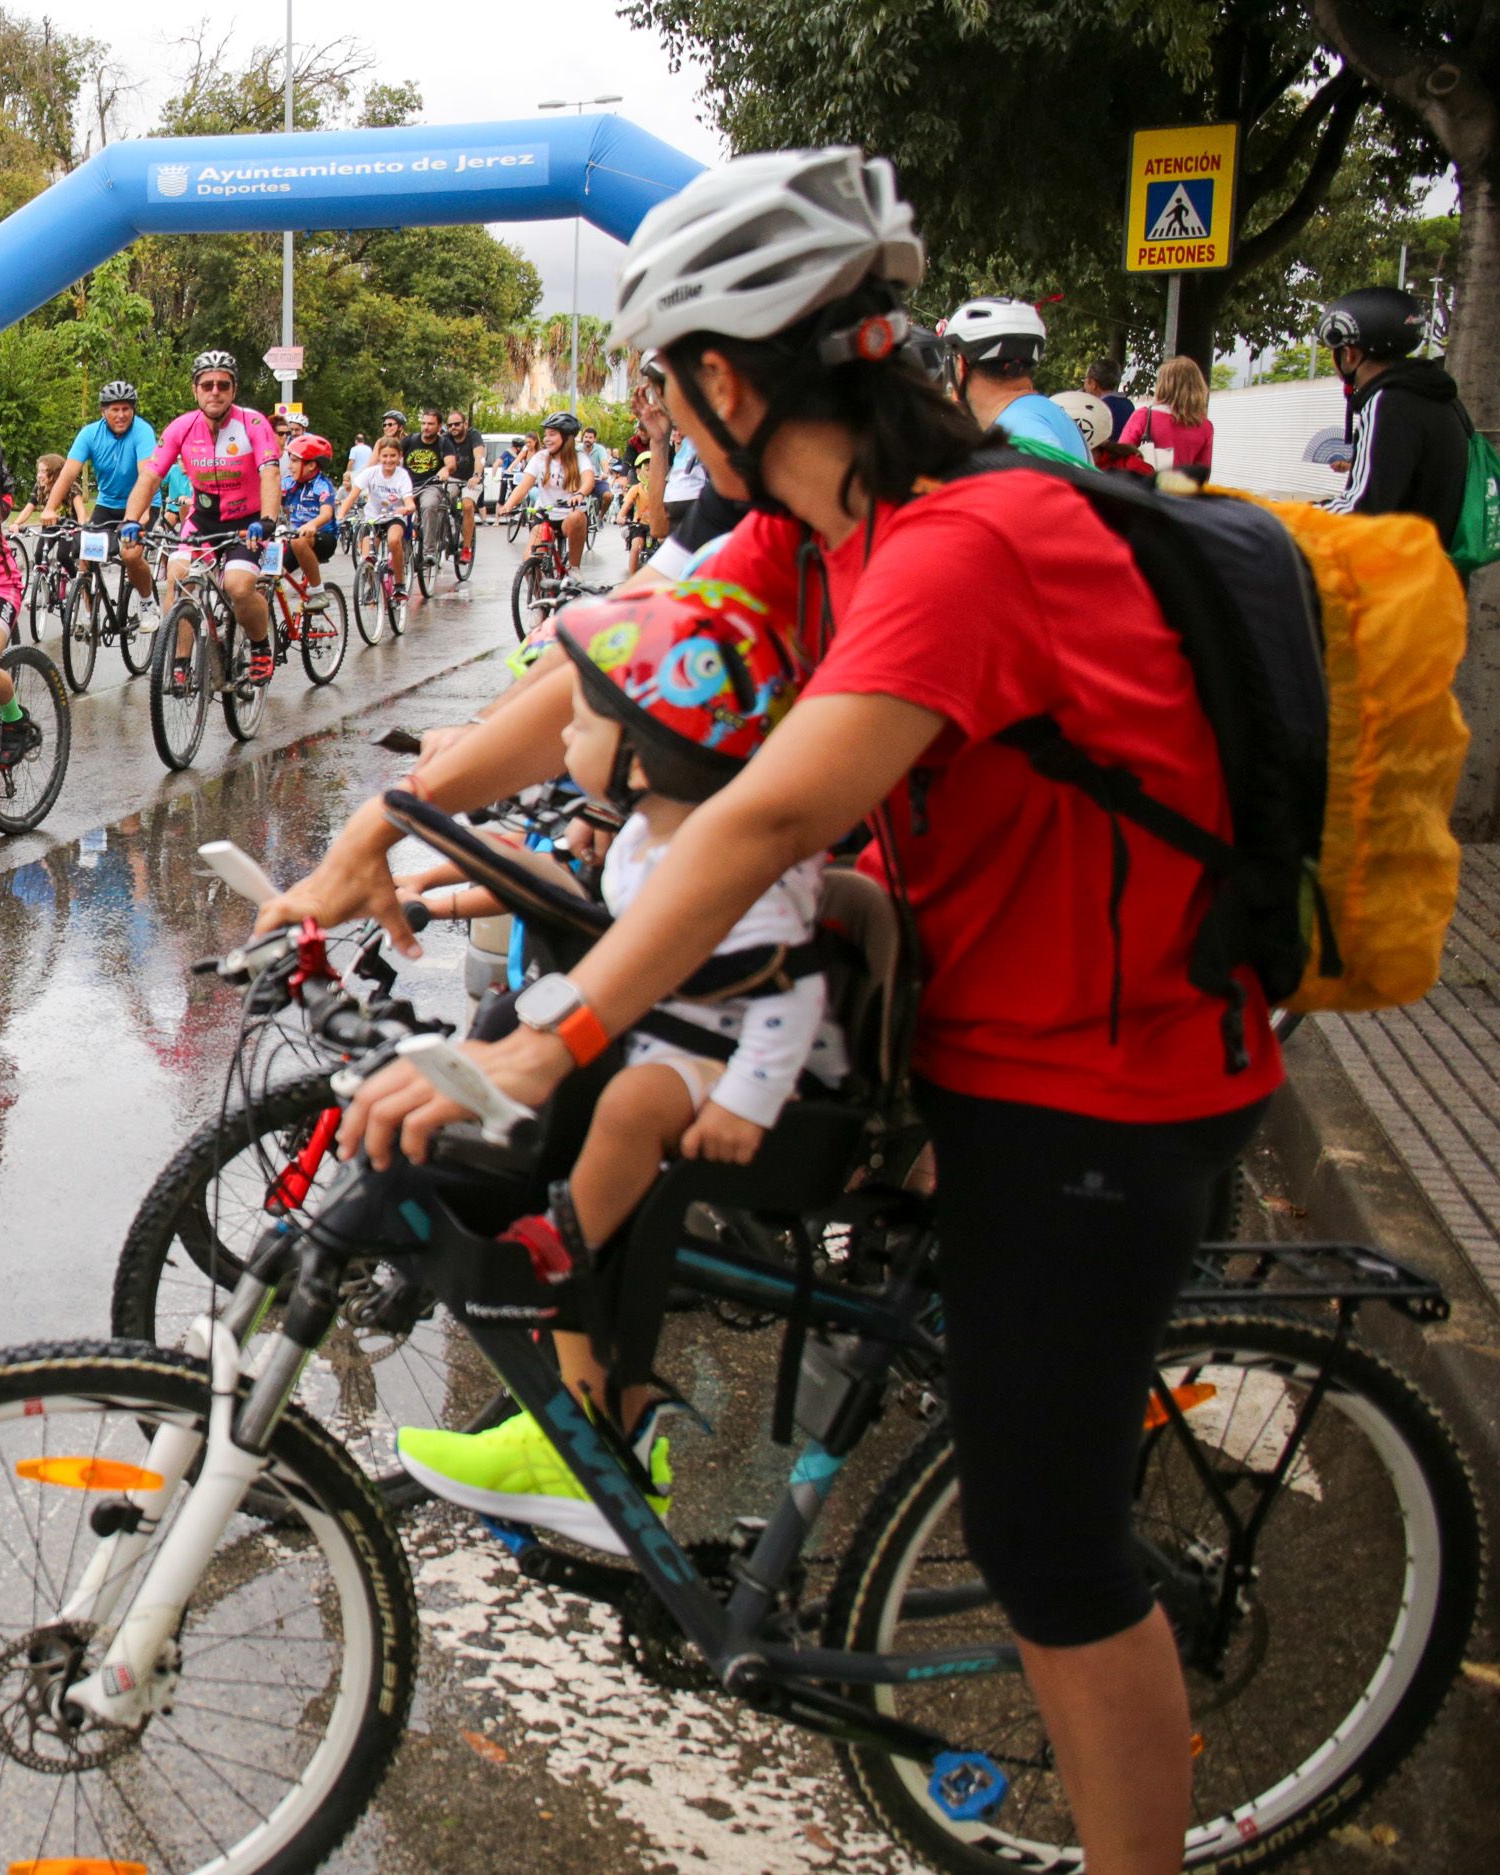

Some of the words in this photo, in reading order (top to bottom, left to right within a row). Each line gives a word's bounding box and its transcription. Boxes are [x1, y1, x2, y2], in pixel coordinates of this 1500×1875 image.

[197, 161, 405, 185] Ayuntamiento
[411, 157, 448, 172] de
[454, 153, 536, 173] Jerez
[1144, 152, 1222, 176] ATENCIÓN
[197, 182, 292, 197] Deportes
[1137, 244, 1216, 266] PEATONES
[338, 1509, 399, 1717] SCHWALBE
